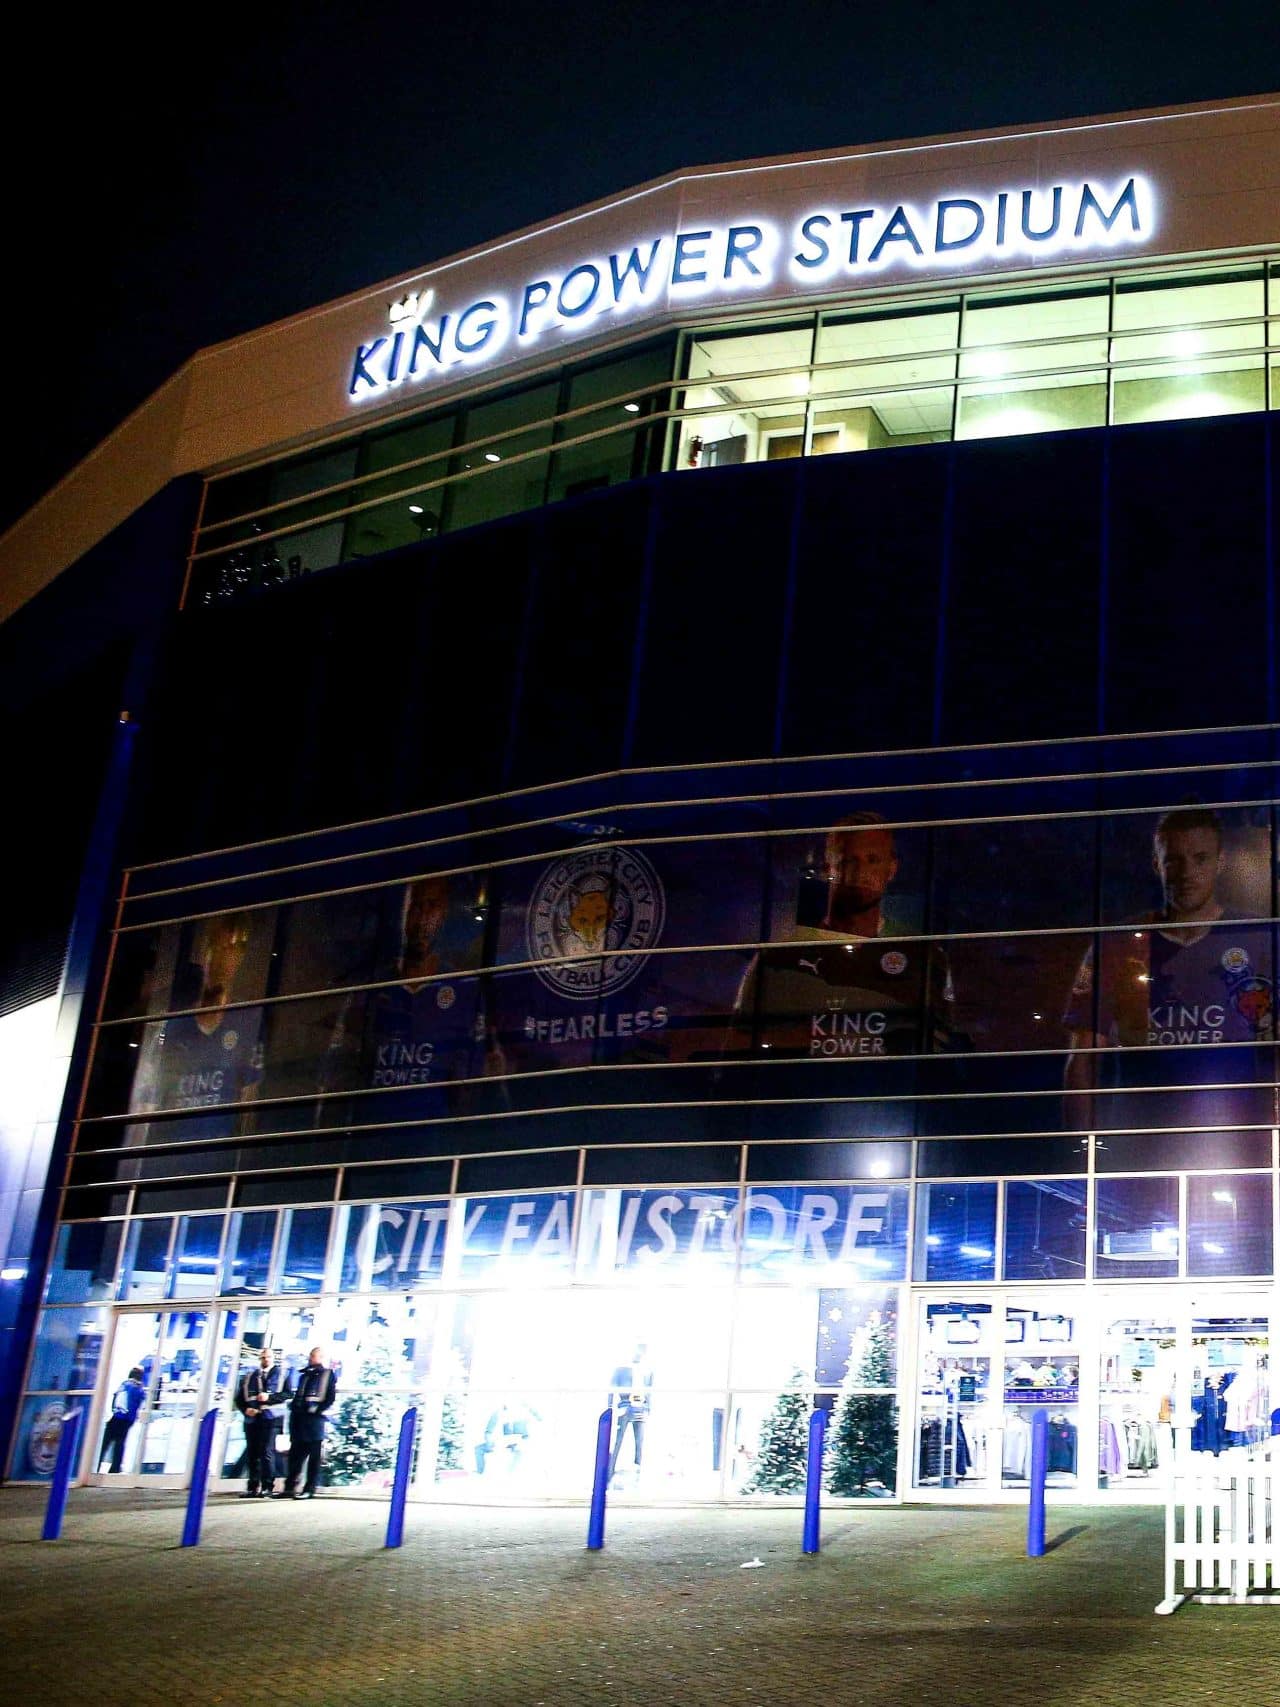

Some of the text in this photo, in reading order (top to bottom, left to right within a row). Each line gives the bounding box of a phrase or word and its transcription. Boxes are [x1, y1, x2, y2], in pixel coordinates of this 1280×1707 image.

[348, 177, 1142, 396] KING POWER STADIUM
[622, 863, 652, 905] CITY
[537, 931, 610, 986] FOTBALL
[523, 1005, 670, 1043] #FEARLESS
[809, 1010, 889, 1037] KING
[1147, 1004, 1226, 1028] KING
[809, 1037, 887, 1056] POWER
[1147, 1030, 1225, 1045] POWER
[375, 1042, 435, 1066] KING
[372, 1067, 431, 1087] POWER
[355, 1203, 488, 1275] CITY
